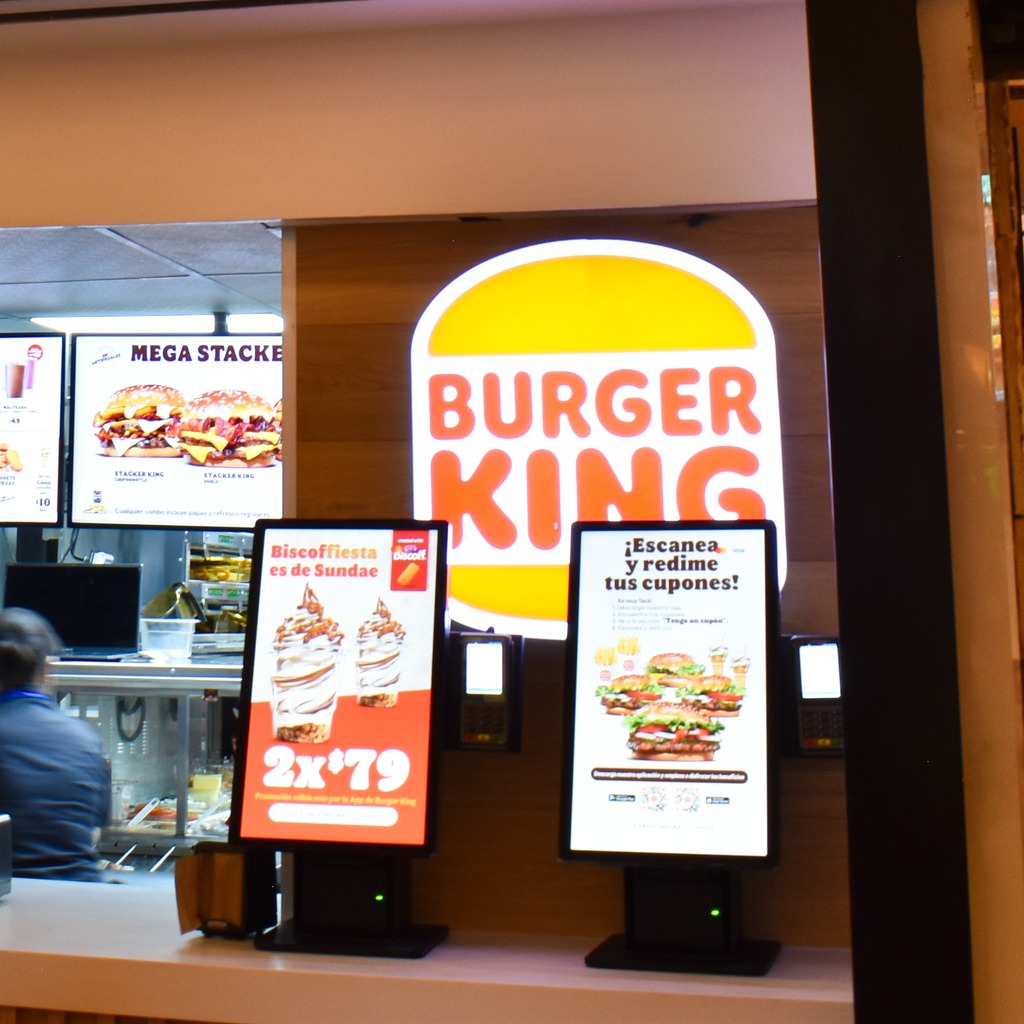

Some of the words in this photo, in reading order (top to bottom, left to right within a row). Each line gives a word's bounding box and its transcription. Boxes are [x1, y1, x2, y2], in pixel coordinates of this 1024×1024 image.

[131, 345, 192, 362] MEGA
[428, 366, 762, 441] BURGER
[430, 445, 766, 550] KING
[270, 544, 378, 559] Biscoffiesta
[625, 538, 719, 557] ¡Escanea
[269, 565, 287, 577] es
[291, 563, 311, 577] de
[314, 563, 378, 577] Sundae
[625, 559, 638, 576] y
[643, 555, 718, 572] redime
[605, 576, 638, 590] tus
[642, 575, 739, 594] cupones!
